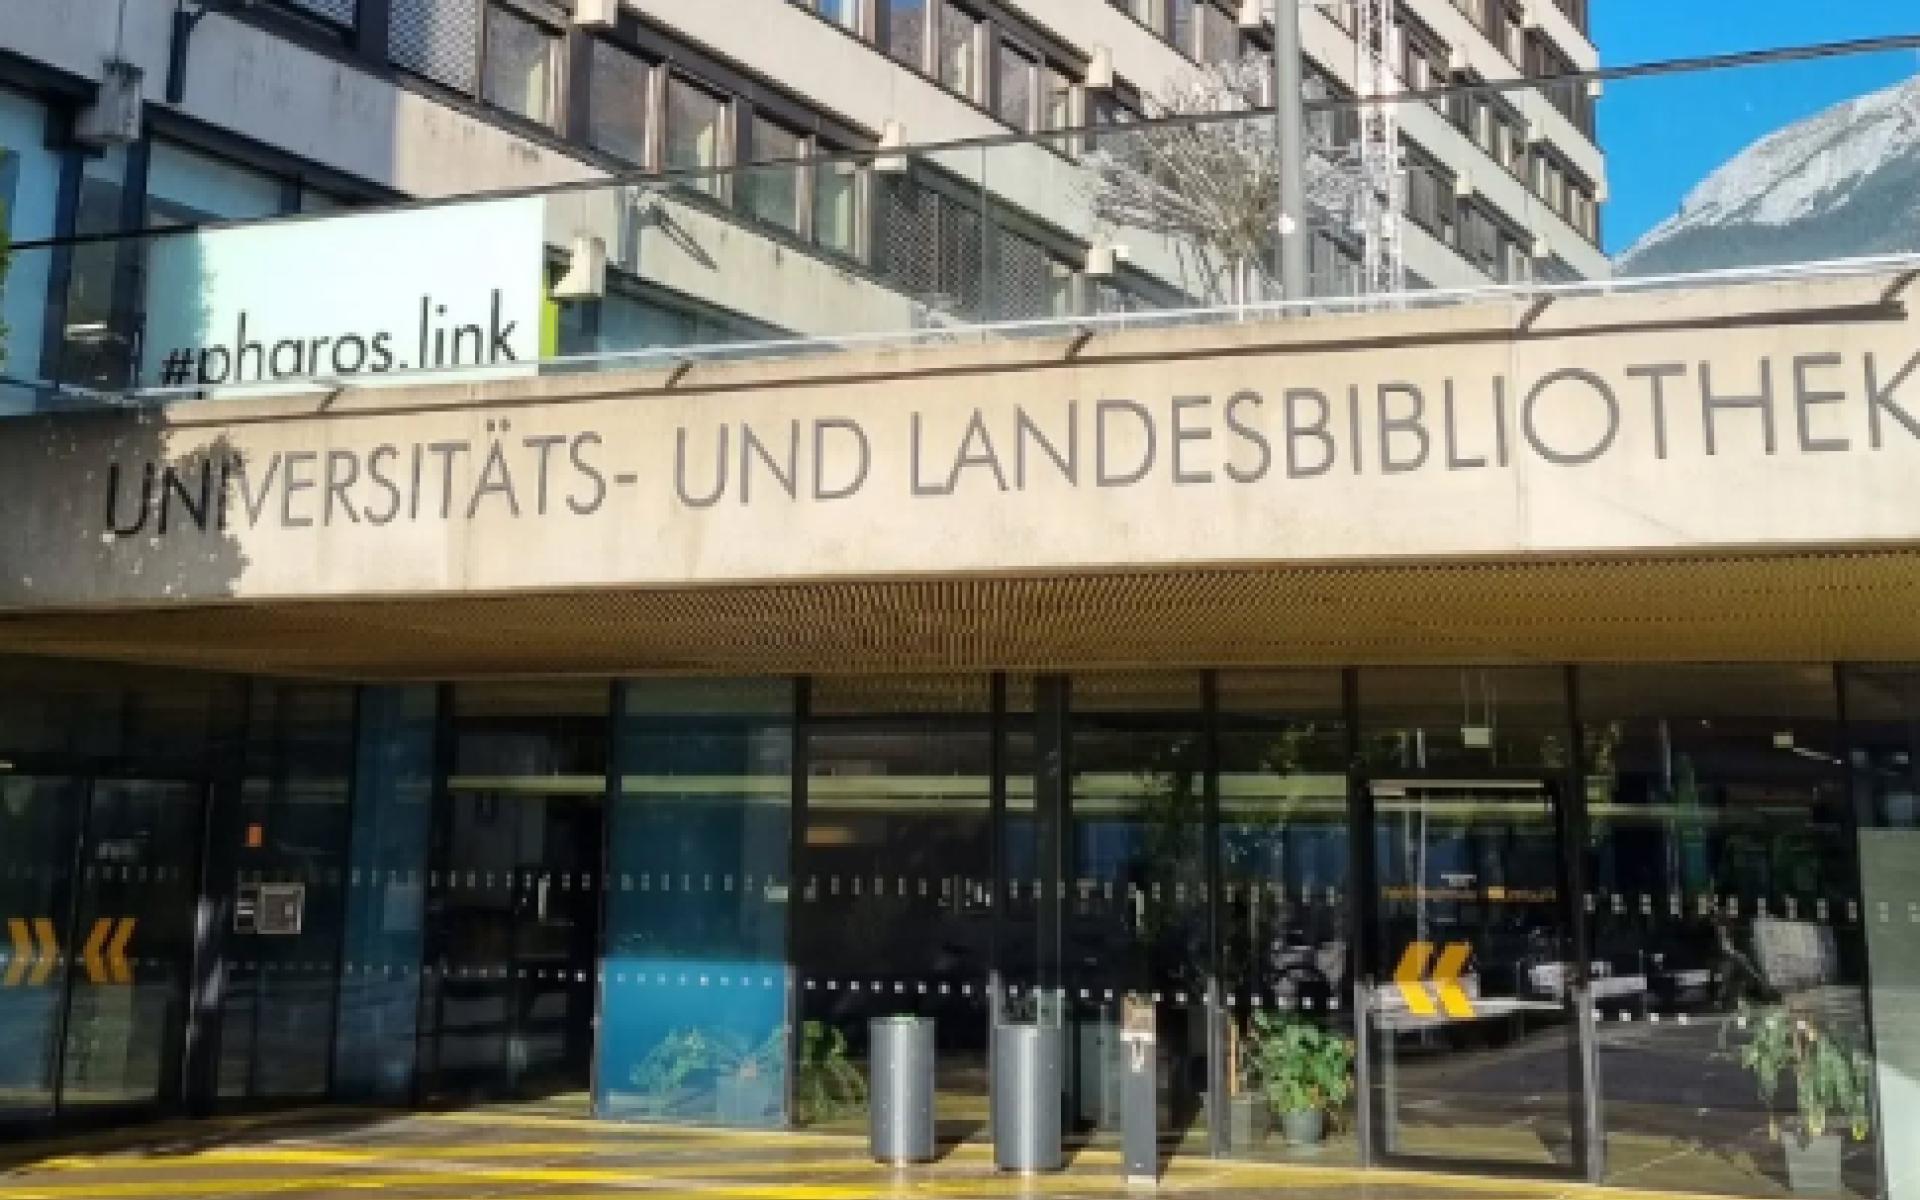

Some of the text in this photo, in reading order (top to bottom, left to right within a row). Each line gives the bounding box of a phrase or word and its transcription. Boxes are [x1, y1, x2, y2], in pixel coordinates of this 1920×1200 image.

[161, 288, 519, 399] #pharos.link
[104, 349, 1920, 537] UNIVERSITÄTS- UND LANDESBIBLIOTHEK
